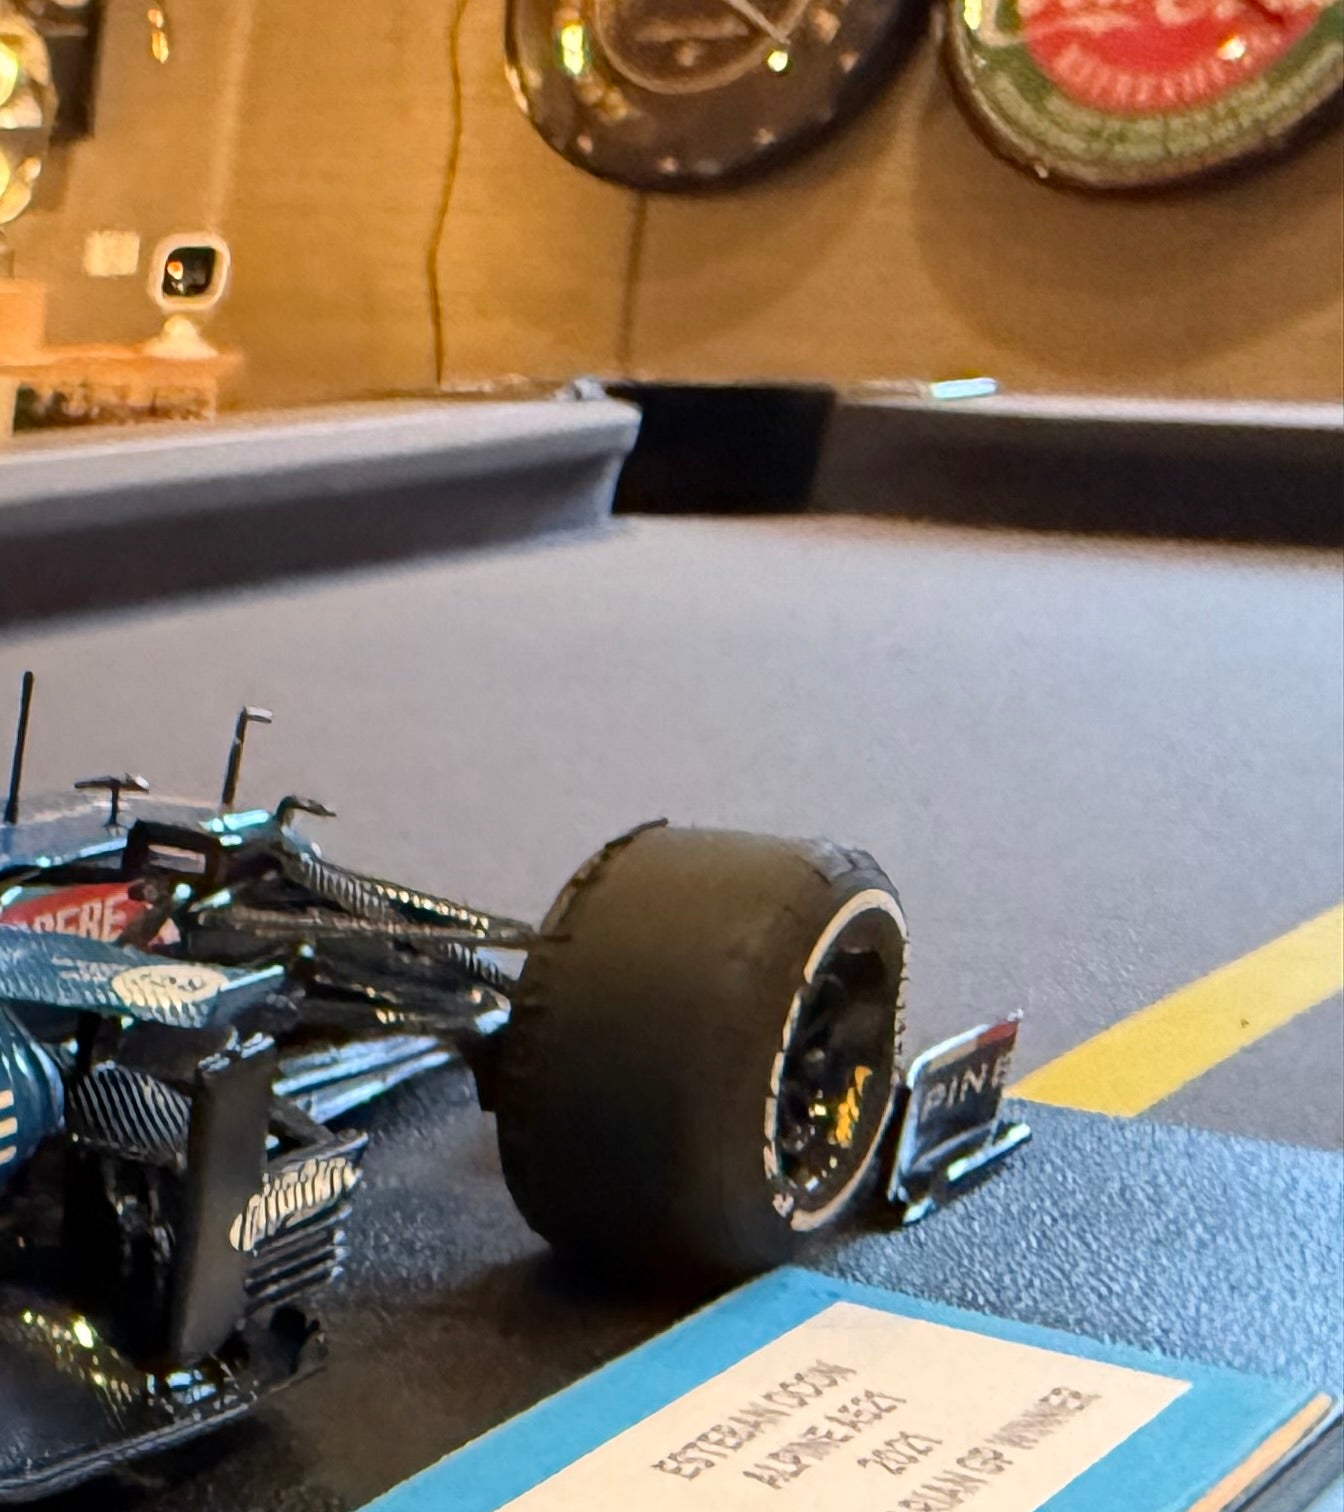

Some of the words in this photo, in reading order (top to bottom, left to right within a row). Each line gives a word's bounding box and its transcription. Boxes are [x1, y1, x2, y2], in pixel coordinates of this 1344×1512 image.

[650, 1399, 792, 1481] ESTEBAN
[982, 1386, 1104, 1452] WINNER
[741, 1423, 855, 1491] ALPINE
